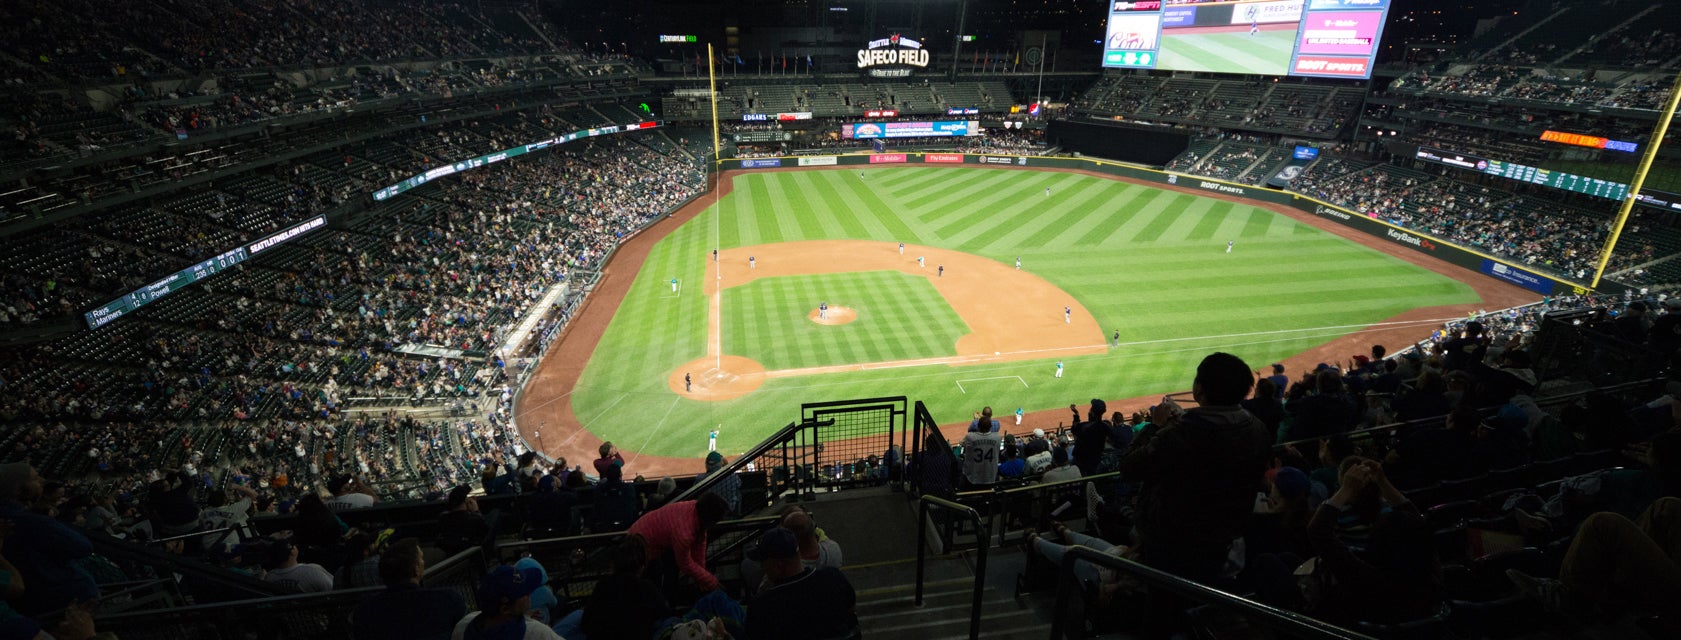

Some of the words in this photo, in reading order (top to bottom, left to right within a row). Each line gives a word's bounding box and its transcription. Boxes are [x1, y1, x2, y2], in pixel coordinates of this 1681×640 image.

[868, 38, 889, 49] SEATTLE
[857, 49, 898, 68] SAFECO
[898, 49, 930, 67] FIELD
[1297, 60, 1328, 70] ROOT
[1200, 181, 1220, 191] ROOT
[1324, 207, 1351, 220] BOEING
[249, 226, 300, 254] SEATTLETIMES.COM
[300, 221, 311, 233] HITS
[311, 217, 324, 229] HARD
[1387, 228, 1422, 246] KeyBank
[151, 286, 170, 299] Powell
[132, 299, 141, 308] 12
[92, 306, 110, 318] Rays
[95, 309, 123, 326] Mariners
[974, 447, 994, 464] 34
